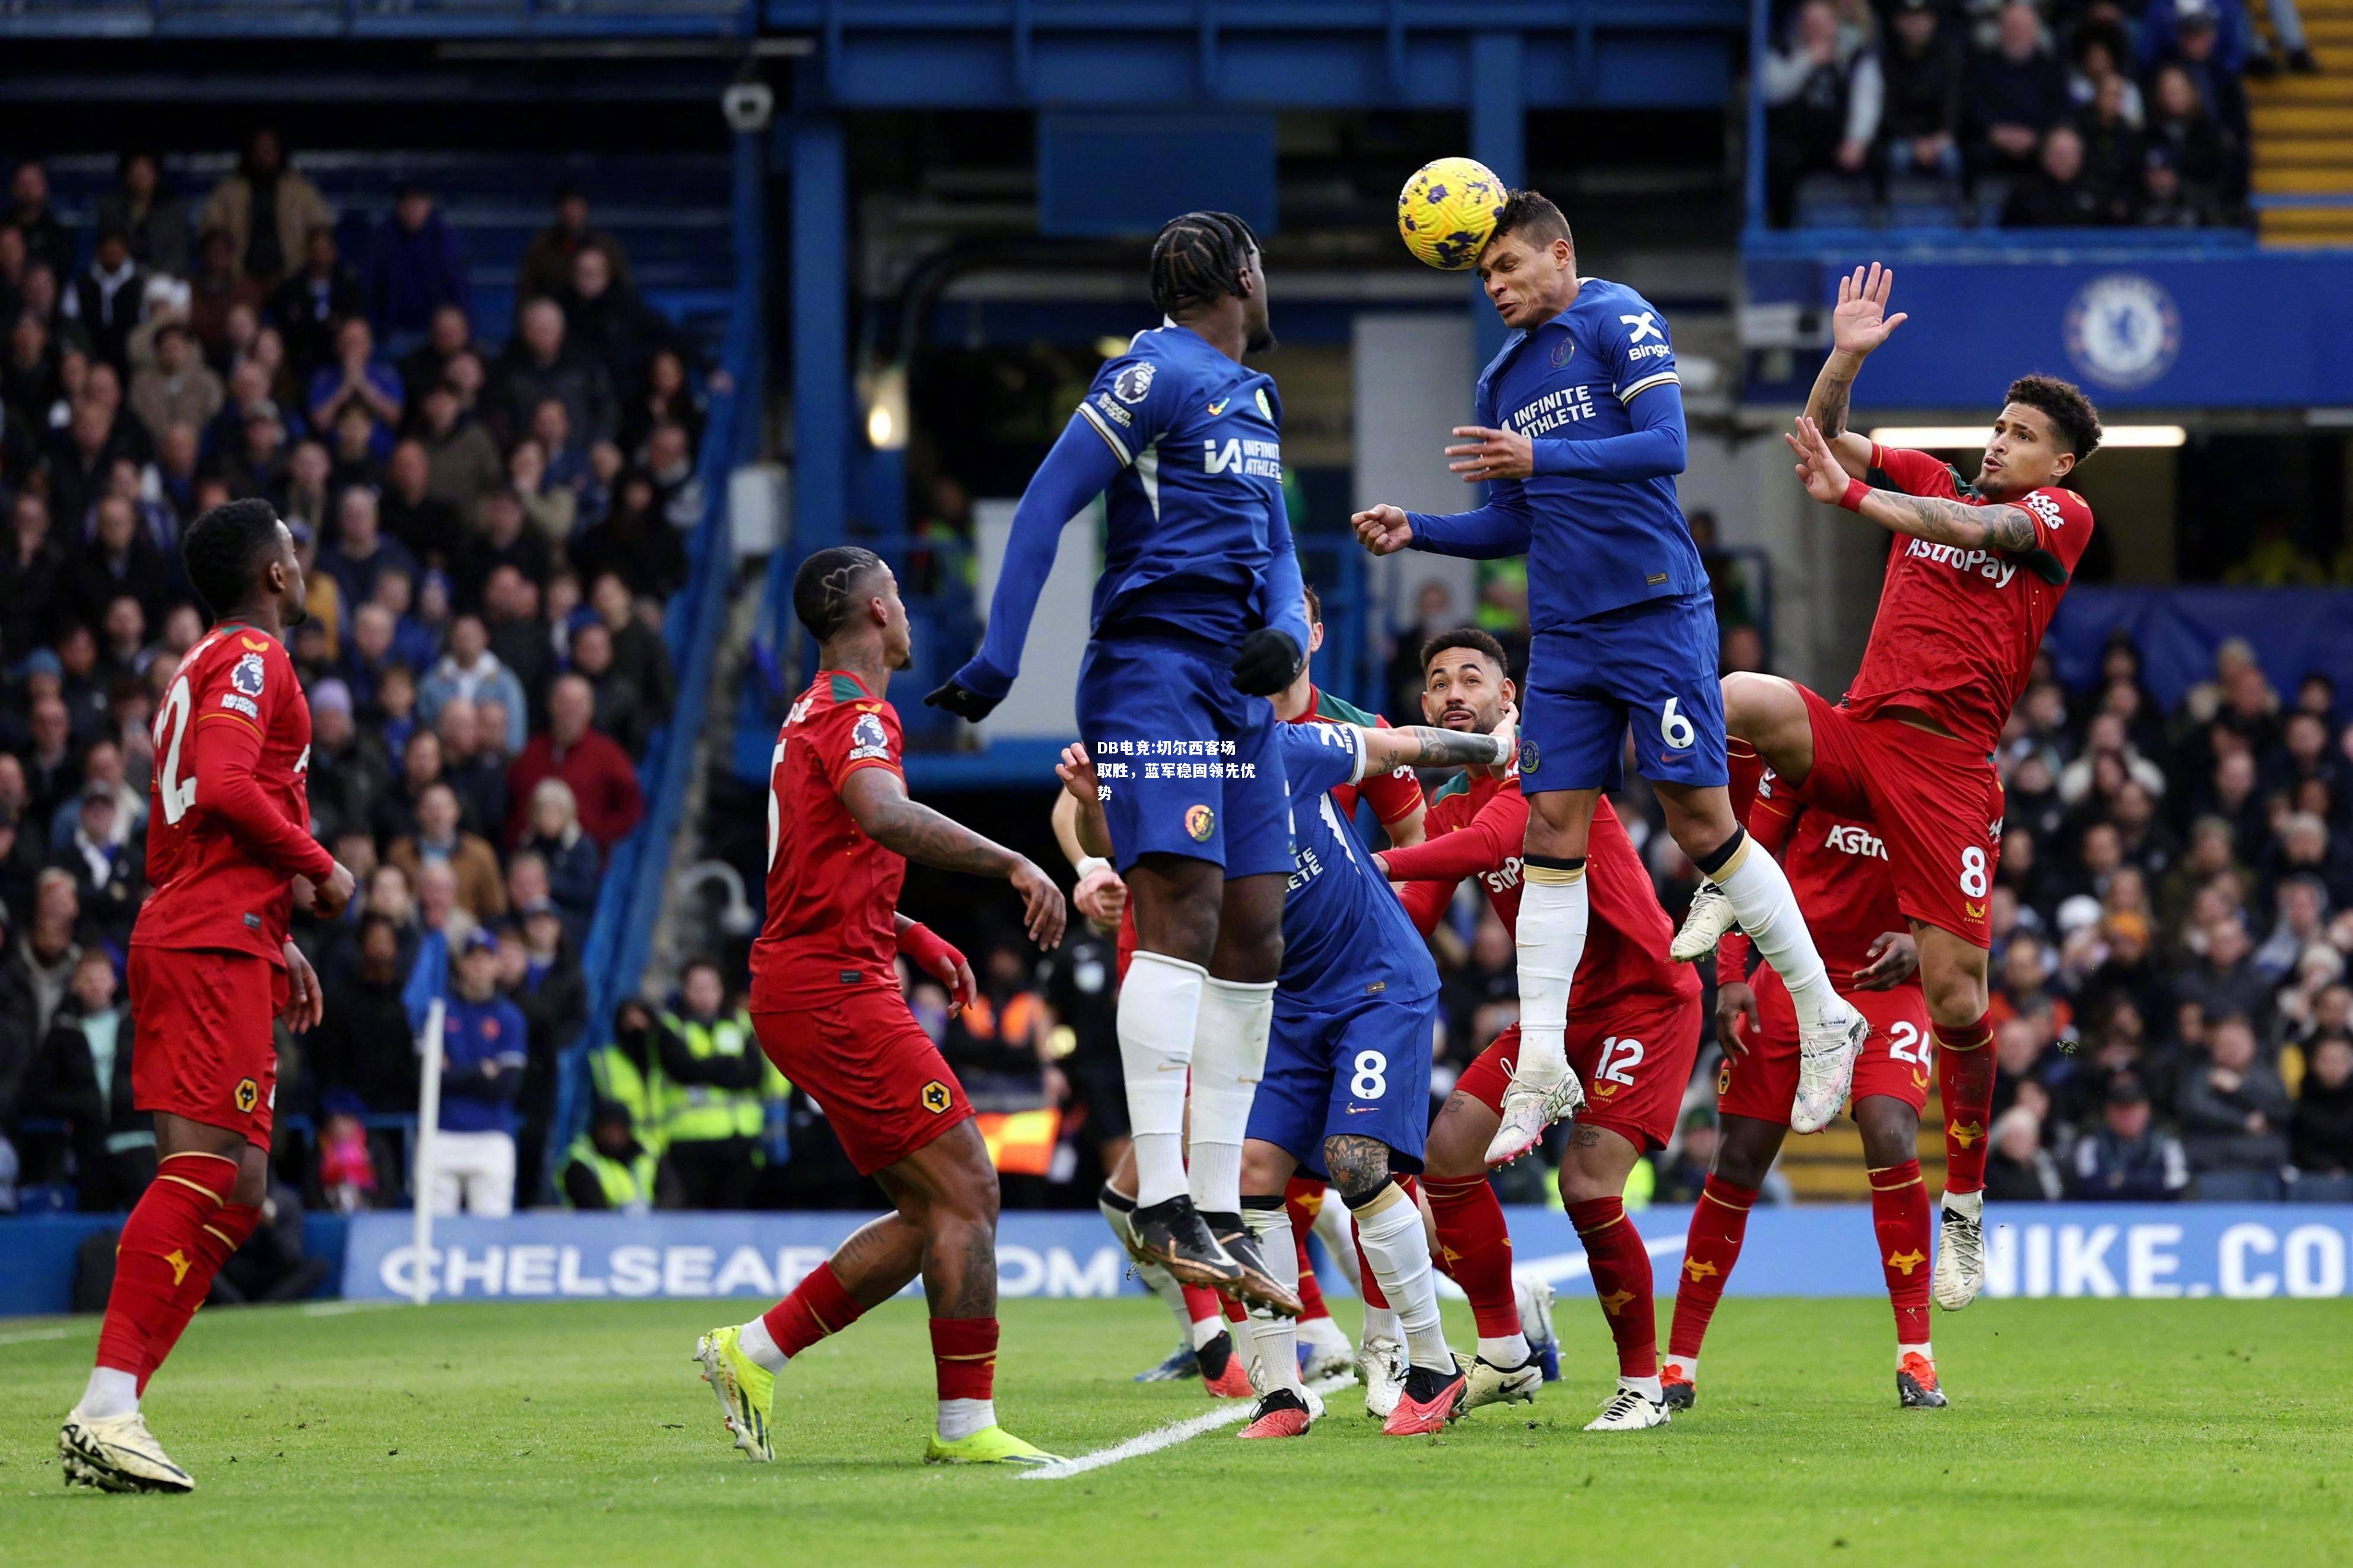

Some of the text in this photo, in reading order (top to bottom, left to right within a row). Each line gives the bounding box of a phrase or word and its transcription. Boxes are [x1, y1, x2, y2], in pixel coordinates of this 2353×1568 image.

[1513, 385, 1591, 427] INFINITE
[1520, 402, 1596, 440] ATHLETE
[1904, 537, 2017, 589] AstroPay
[1661, 696, 1695, 749] 6
[1285, 858, 1324, 893] ETE
[1960, 845, 1987, 898] 8
[1595, 1036, 1645, 1087] 12
[1890, 1020, 1932, 1077] 24
[1351, 1049, 1387, 1100] 8
